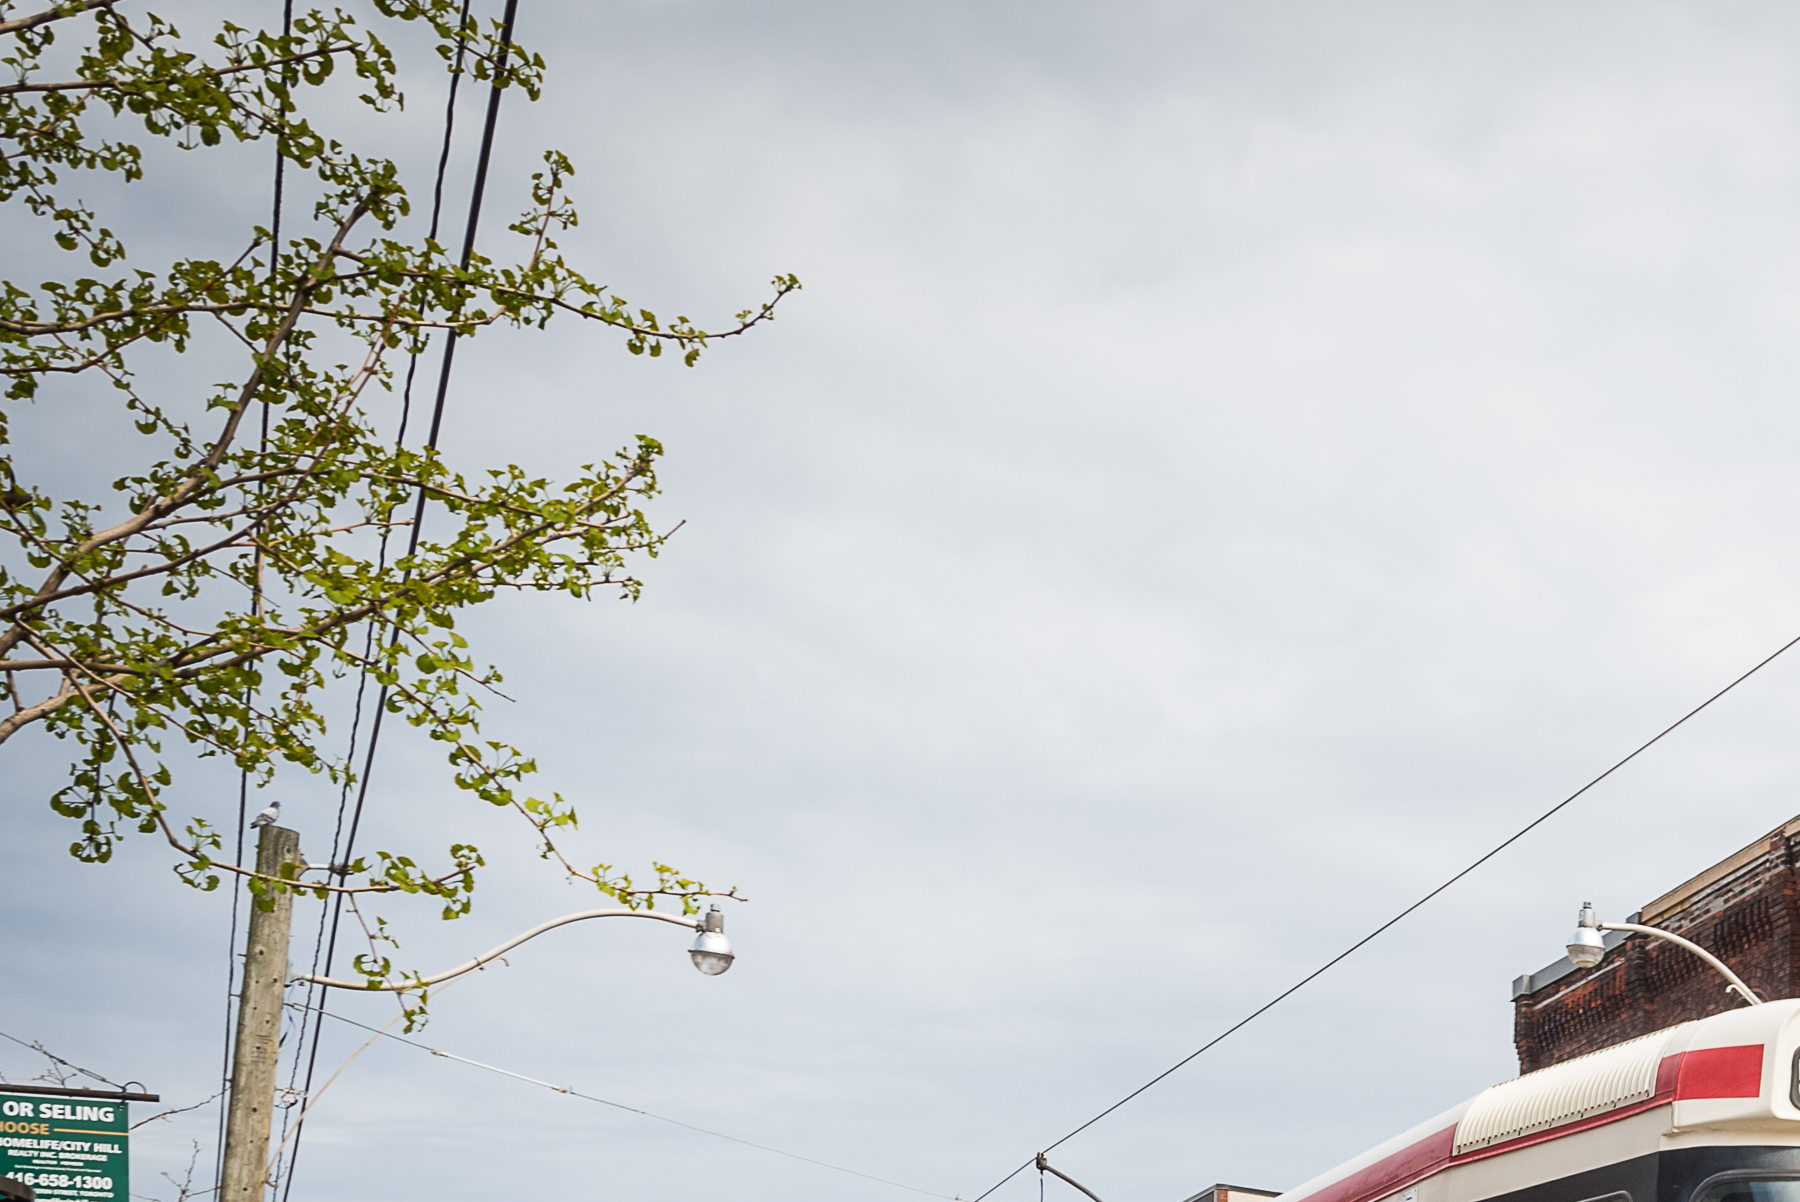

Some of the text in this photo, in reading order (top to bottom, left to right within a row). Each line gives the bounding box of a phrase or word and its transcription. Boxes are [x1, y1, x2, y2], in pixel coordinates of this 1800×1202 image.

[39, 1103, 115, 1122] SELING
[93, 1142, 122, 1154] HILL
[5, 1172, 113, 1190] 416-658-1300
